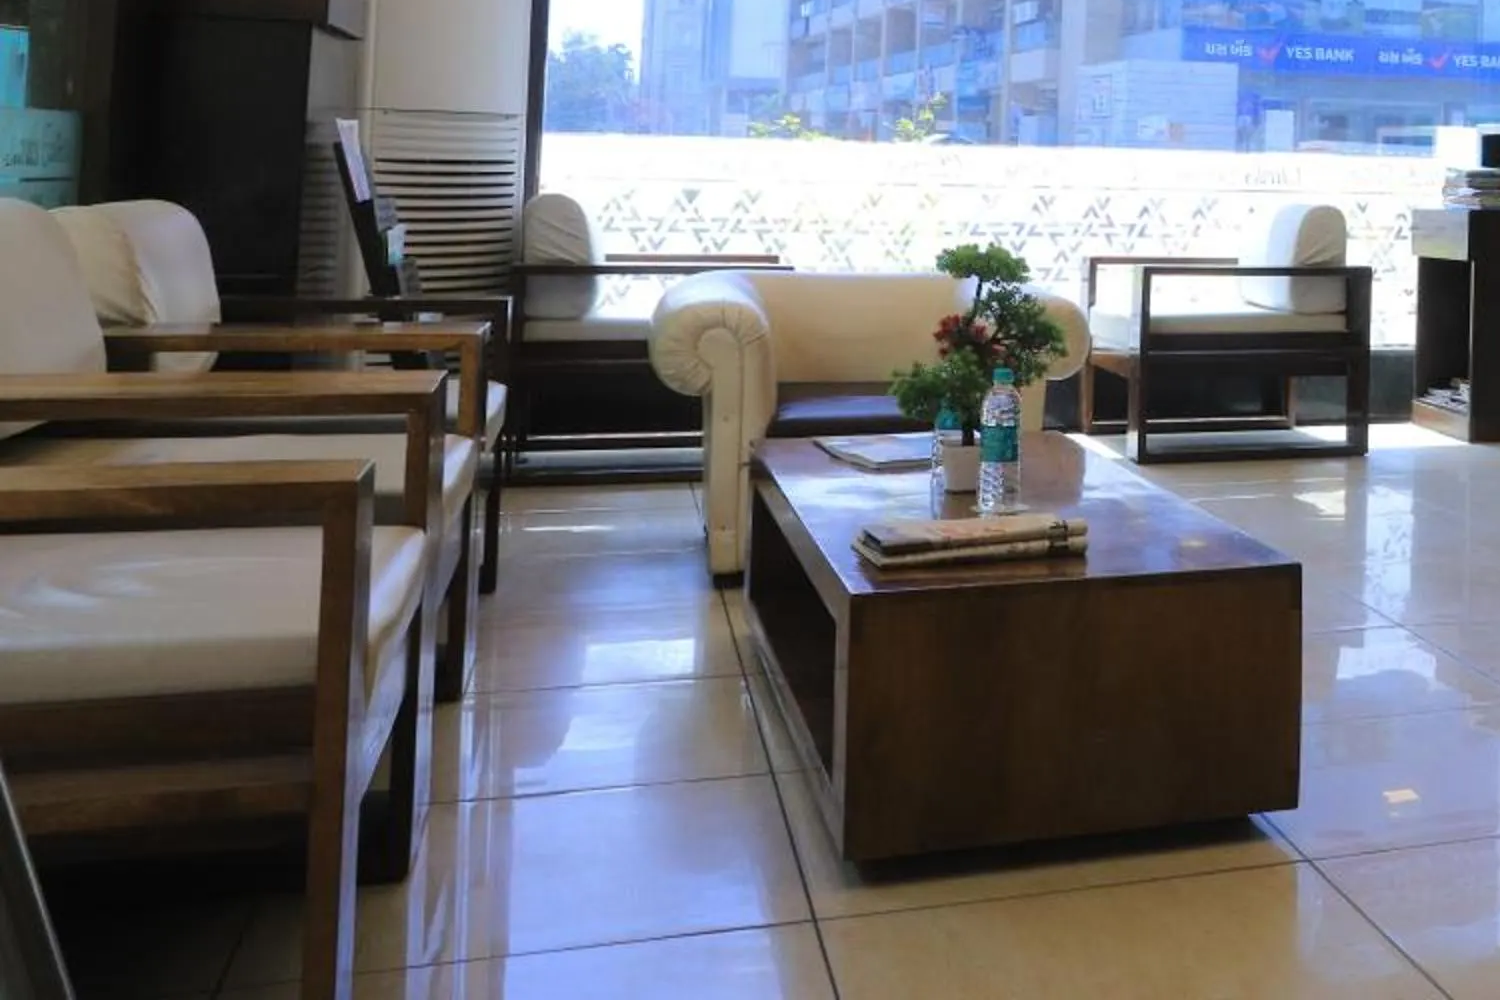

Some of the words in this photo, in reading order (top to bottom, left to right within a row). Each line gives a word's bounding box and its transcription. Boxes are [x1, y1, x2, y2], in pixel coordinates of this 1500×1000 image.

[1286, 47, 1312, 60] YES
[1315, 48, 1354, 63] BANK
[1453, 55, 1477, 68] YES
